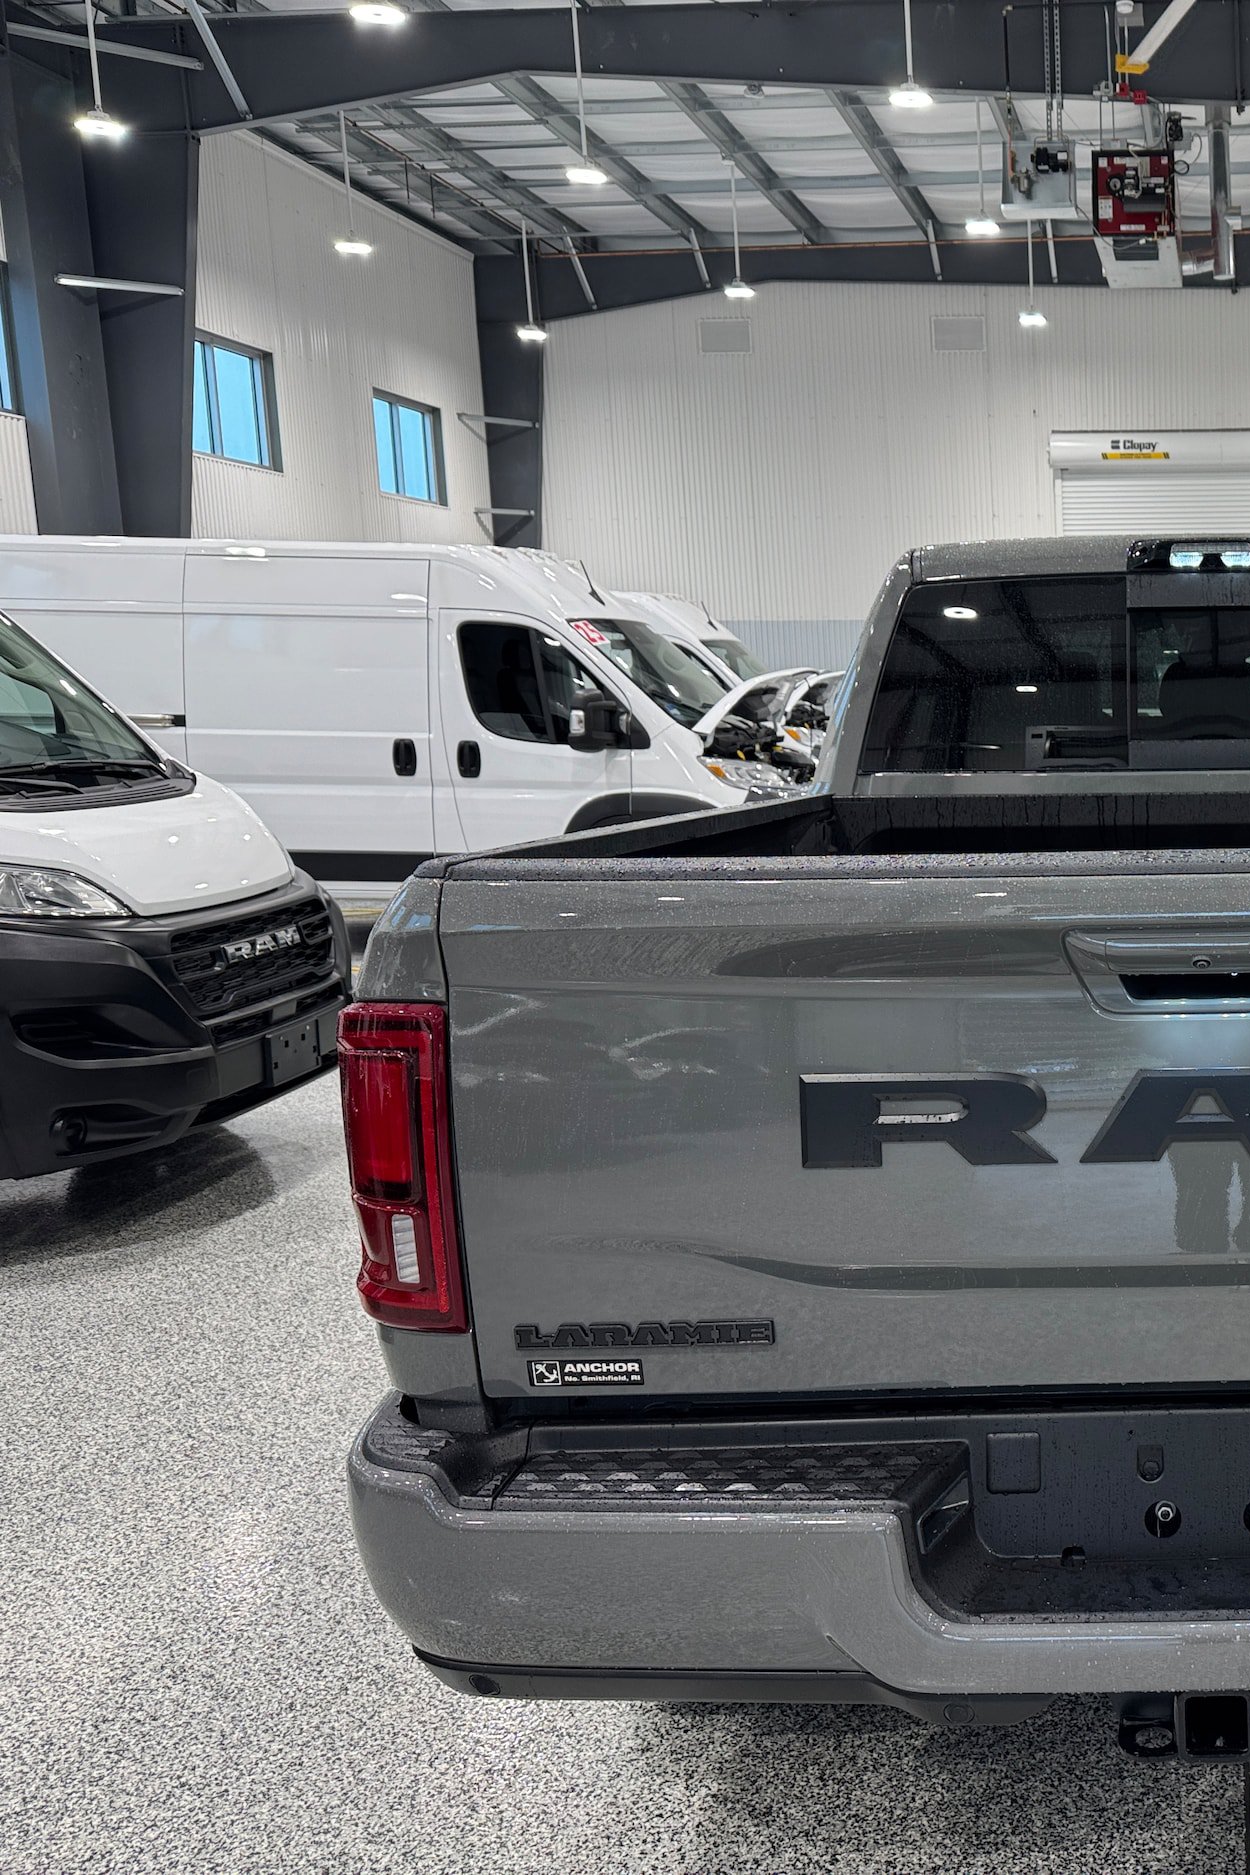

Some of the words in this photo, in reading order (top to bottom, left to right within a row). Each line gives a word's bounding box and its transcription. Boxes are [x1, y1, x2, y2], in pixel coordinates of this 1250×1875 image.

[1123, 439, 1157, 452] Clopay
[574, 621, 605, 643] 25
[224, 924, 302, 964] RAM
[514, 1318, 775, 1350] LARAMIE
[564, 1361, 640, 1373] ANCHOR
[581, 1374, 629, 1382] Smithfield,
